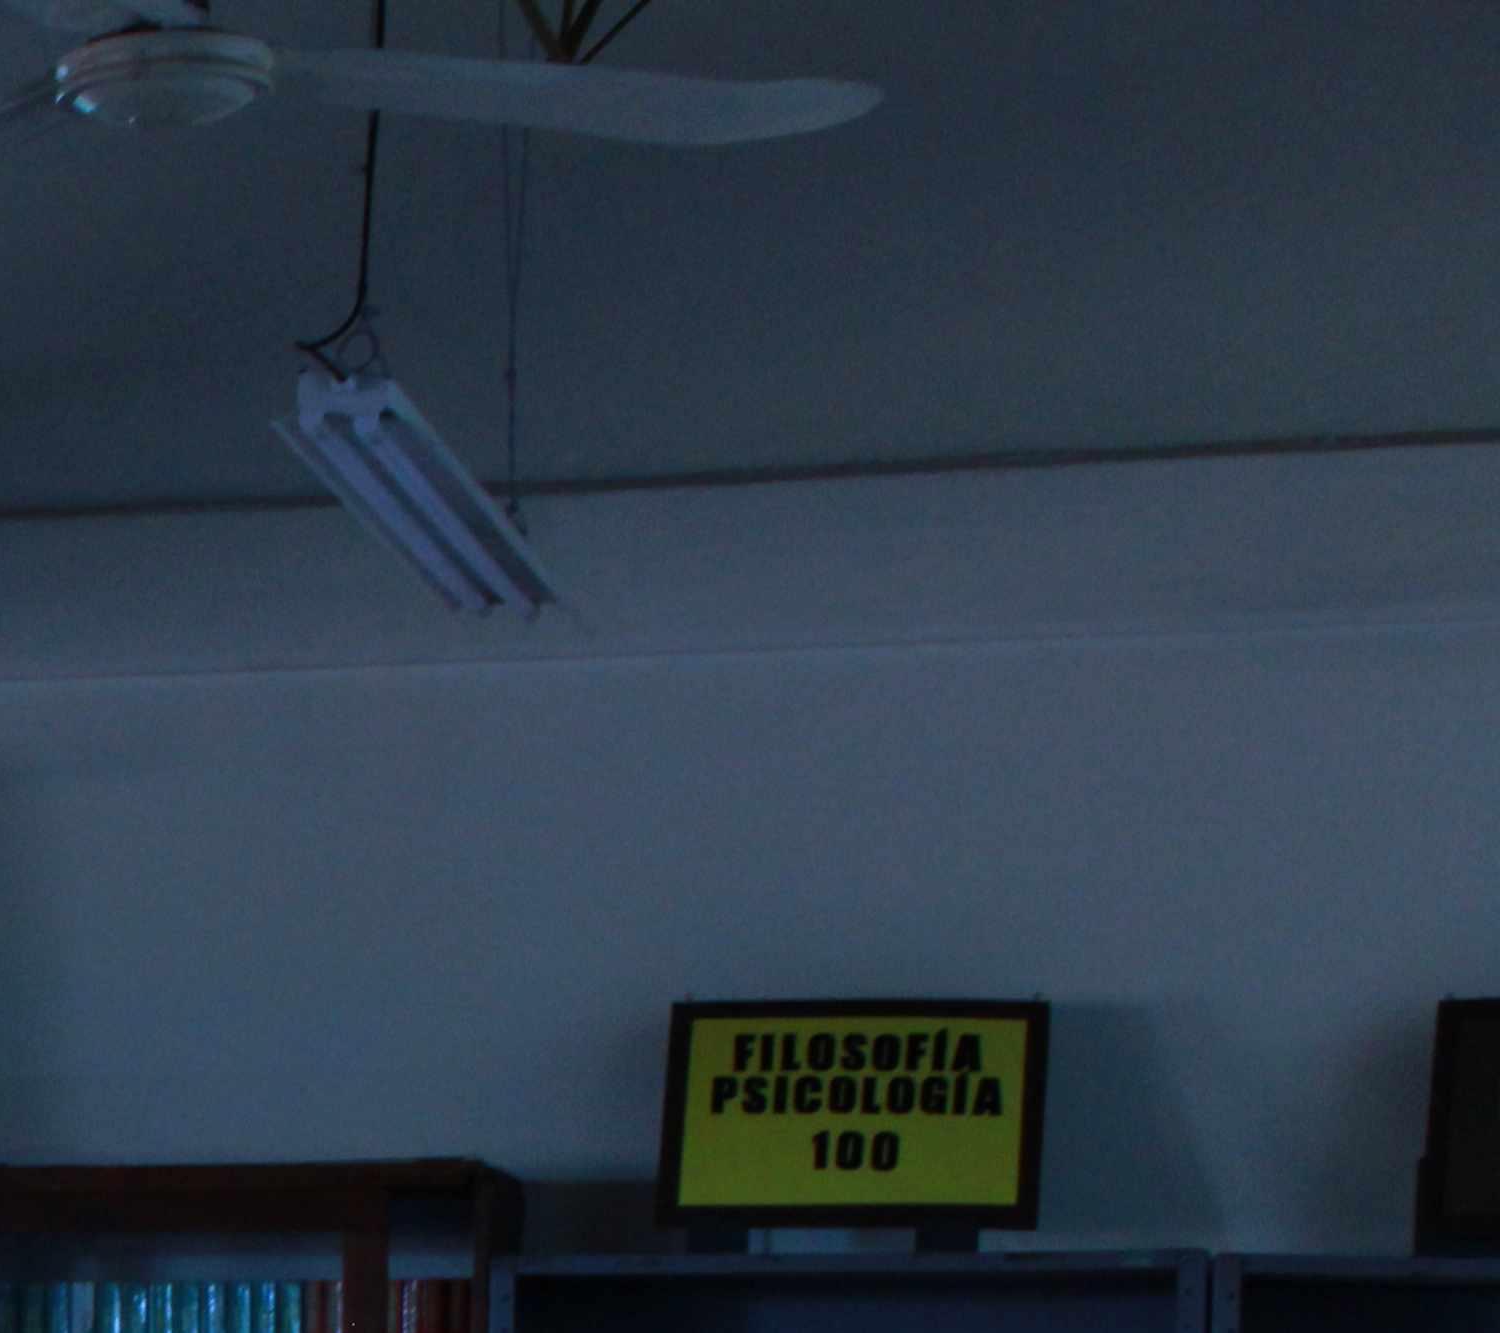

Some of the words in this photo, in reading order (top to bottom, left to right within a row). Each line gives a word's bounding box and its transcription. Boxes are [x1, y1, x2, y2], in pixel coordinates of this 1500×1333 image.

[732, 1028, 982, 1072] FILOSOFÍA
[710, 1071, 1003, 1116] PSICOLOGÍA
[812, 1130, 899, 1171] 100
